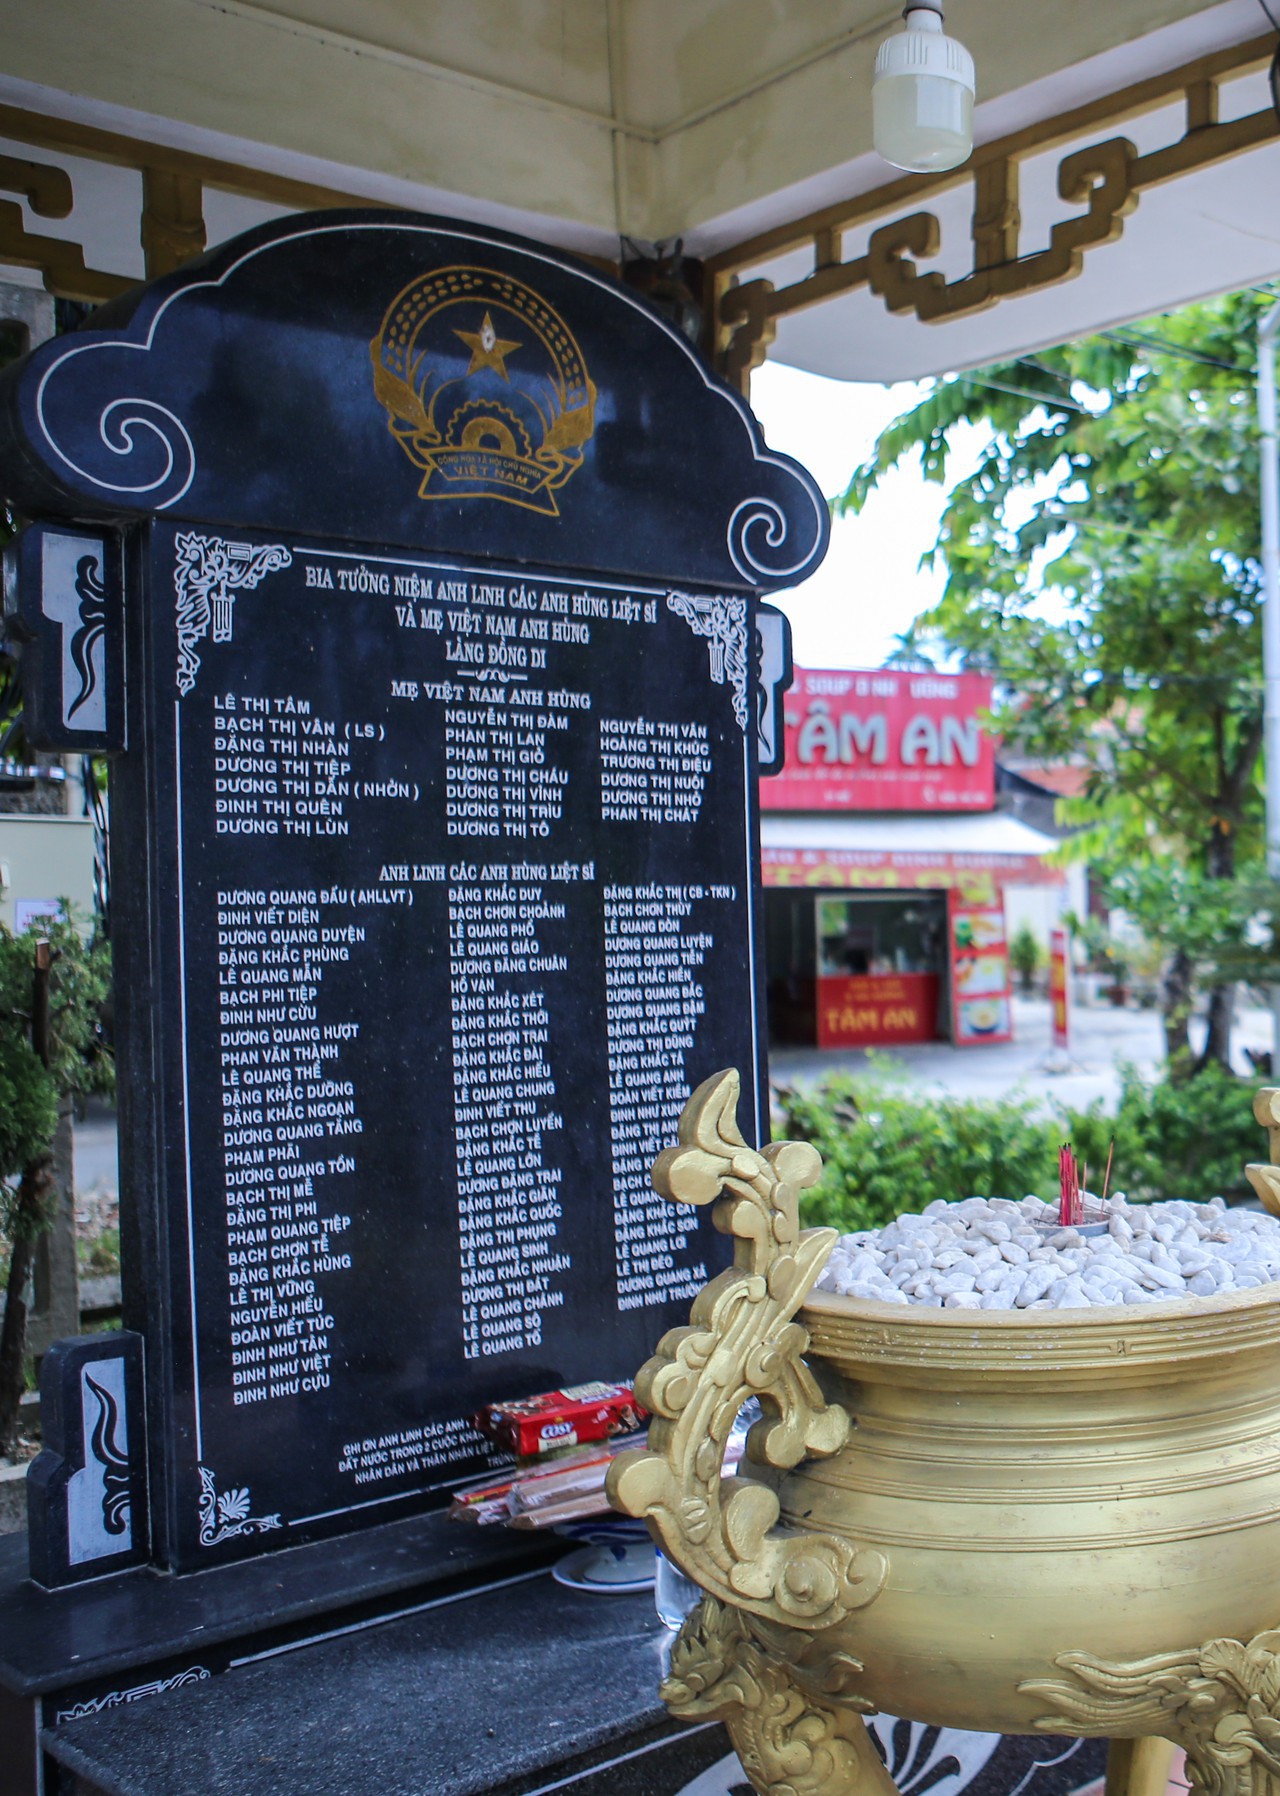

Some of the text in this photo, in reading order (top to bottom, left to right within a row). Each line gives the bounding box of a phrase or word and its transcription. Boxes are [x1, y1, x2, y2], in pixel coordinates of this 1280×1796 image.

[454, 464, 528, 486] VIỆT NAM
[305, 568, 333, 589] BIA
[337, 568, 389, 595] TƯỞNG
[394, 574, 432, 602] NIỆM
[436, 581, 467, 603] ANH
[471, 584, 504, 607] LINH
[508, 585, 536, 610] CÁC
[540, 591, 568, 613] ANH
[572, 591, 608, 617] HÙNG
[611, 595, 640, 623] LIỆT
[396, 604, 589, 644] VÀ MẸ VIỆT NAM ANH HÙNG
[446, 639, 545, 668] LÀNG ĐỒNG DI
[214, 693, 310, 714] LÊ THỊ TÂM
[391, 681, 590, 709] MẸ VIỆT NAM ANH HÙNG
[214, 716, 334, 735] BẠCH THỊ VÂN
[445, 707, 567, 729] NGUYỄN THỊ ĐÀM
[600, 717, 654, 734] NGUYỄN
[657, 723, 677, 738] THỊ
[214, 735, 348, 755] ĐẶNG THỊ NHÀN
[489, 731, 513, 746] THỊ
[516, 732, 544, 745] LAN
[600, 735, 646, 751] HOÀNG
[649, 740, 670, 755] THỊ
[901, 714, 980, 766] AN
[445, 747, 488, 762] PHẠM
[492, 749, 515, 764] THỊ
[600, 754, 711, 773] TRƯƠNG THỊ ĐIỆU
[215, 758, 350, 777] DƯƠNG THỊ TIỆP
[446, 767, 498, 780] DƯƠNG
[502, 769, 525, 784] THỊ
[215, 778, 277, 792] DƯƠNG
[282, 780, 309, 796] THỊ
[601, 773, 704, 790] DƯƠNG THỊ NUÔI
[446, 785, 525, 802] DƯƠNG THỊ
[601, 791, 647, 804] DƯƠNG
[650, 792, 671, 807] THỊ
[215, 799, 342, 816] ĐINH THỊ QUÊN
[446, 803, 498, 816] DƯƠNG
[502, 804, 525, 819] THỊ
[601, 807, 637, 819] PHAN
[640, 808, 661, 823] THỊ
[216, 818, 348, 836] DƯƠNG THỊ LÙN
[447, 821, 549, 838] DƯƠNG THỊ TÔ
[379, 866, 408, 881] ANH
[413, 866, 445, 881] LINH
[449, 862, 476, 880] CÁC
[480, 865, 507, 880] ANH
[511, 862, 547, 880] HÙNG
[550, 861, 578, 883] LIỆT
[217, 891, 265, 904] DƯƠNG
[269, 891, 316, 903] QUANG
[217, 906, 319, 925] ĐINH VIẾT DIỆN
[218, 925, 365, 944] DƯƠNG QUANG DUYỆN
[604, 918, 617, 933] LÊ
[619, 920, 656, 933] QUANG
[449, 940, 464, 956] LÊ
[467, 942, 508, 955] QUANG
[643, 937, 678, 949] QUANG
[218, 945, 348, 966] ĐẶNG KHẮC PHÙNG
[219, 984, 317, 1006] BẠCH PHI TIỆP
[826, 1005, 918, 1033] TÂM AN
[343, 1441, 361, 1457] GHI
[378, 1434, 399, 1448] ANH
[400, 1429, 423, 1445] LINH
[445, 1418, 465, 1434] ANH
[390, 1443, 424, 1460] TRONG
[424, 1442, 431, 1453] 2
